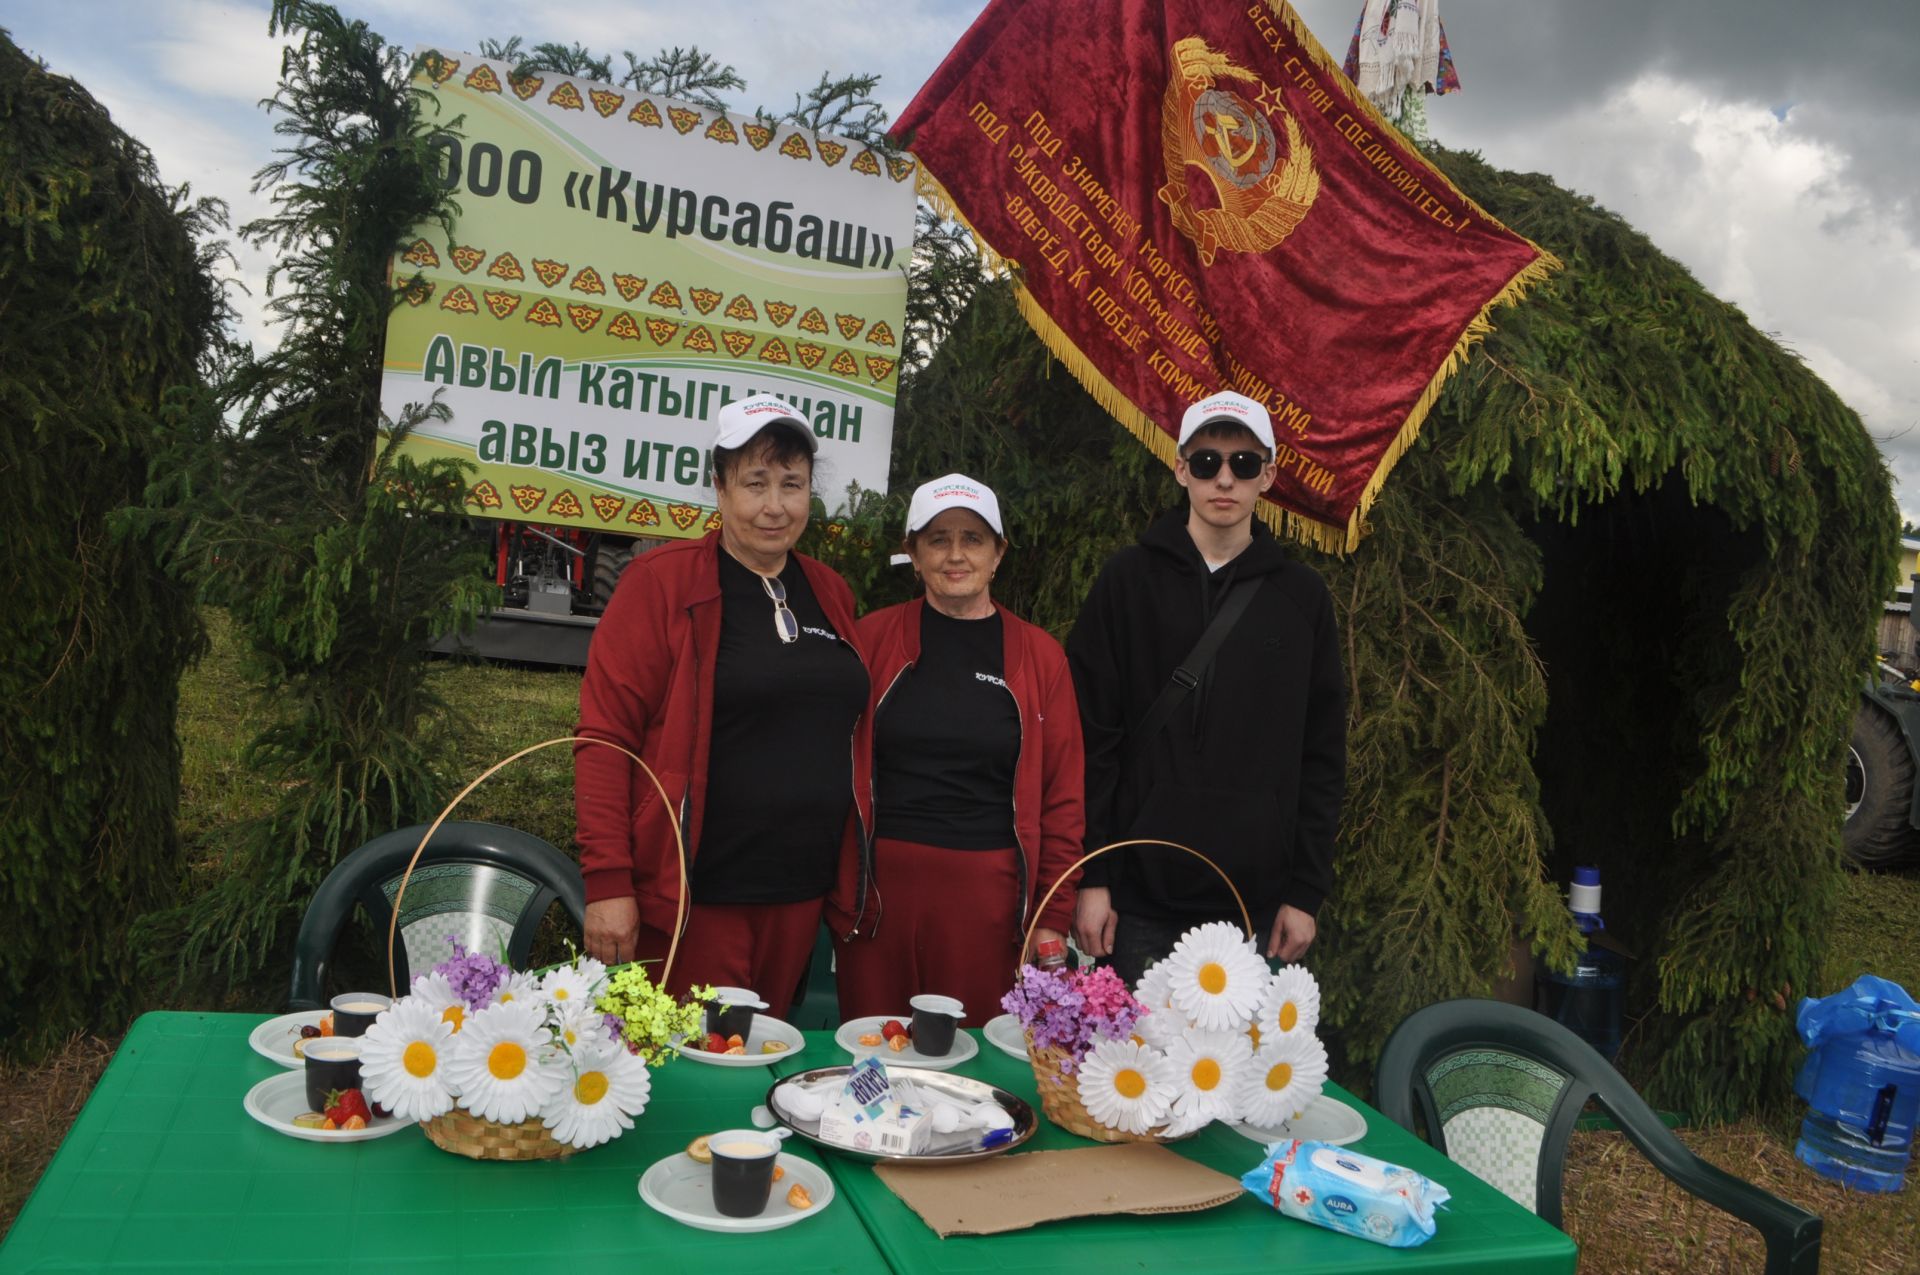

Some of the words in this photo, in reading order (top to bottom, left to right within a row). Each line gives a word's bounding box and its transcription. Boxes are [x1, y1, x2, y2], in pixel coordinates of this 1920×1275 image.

[1247, 5, 1286, 54] ВСЕХ
[1283, 56, 1335, 114] СТРАН
[1334, 112, 1472, 234] СОЕДИНЯЙТЕСЬ!
[429, 134, 543, 205] ООО
[563, 165, 895, 269] «Курсабаш»
[1062, 155, 1143, 244] ЗНАМЕНЕМ
[968, 101, 1009, 145] ПОД
[1007, 143, 1125, 278] РУКОВОДСТВОМ
[1275, 442, 1337, 497] АРТИИ
[1067, 264, 1092, 289] К
[1086, 286, 1150, 354] ПОБЕДЕ
[423, 334, 564, 400] Авыл
[478, 419, 608, 475] авыз
[850, 1067, 890, 1106] САХАР
[1326, 1198, 1355, 1213] AURA
